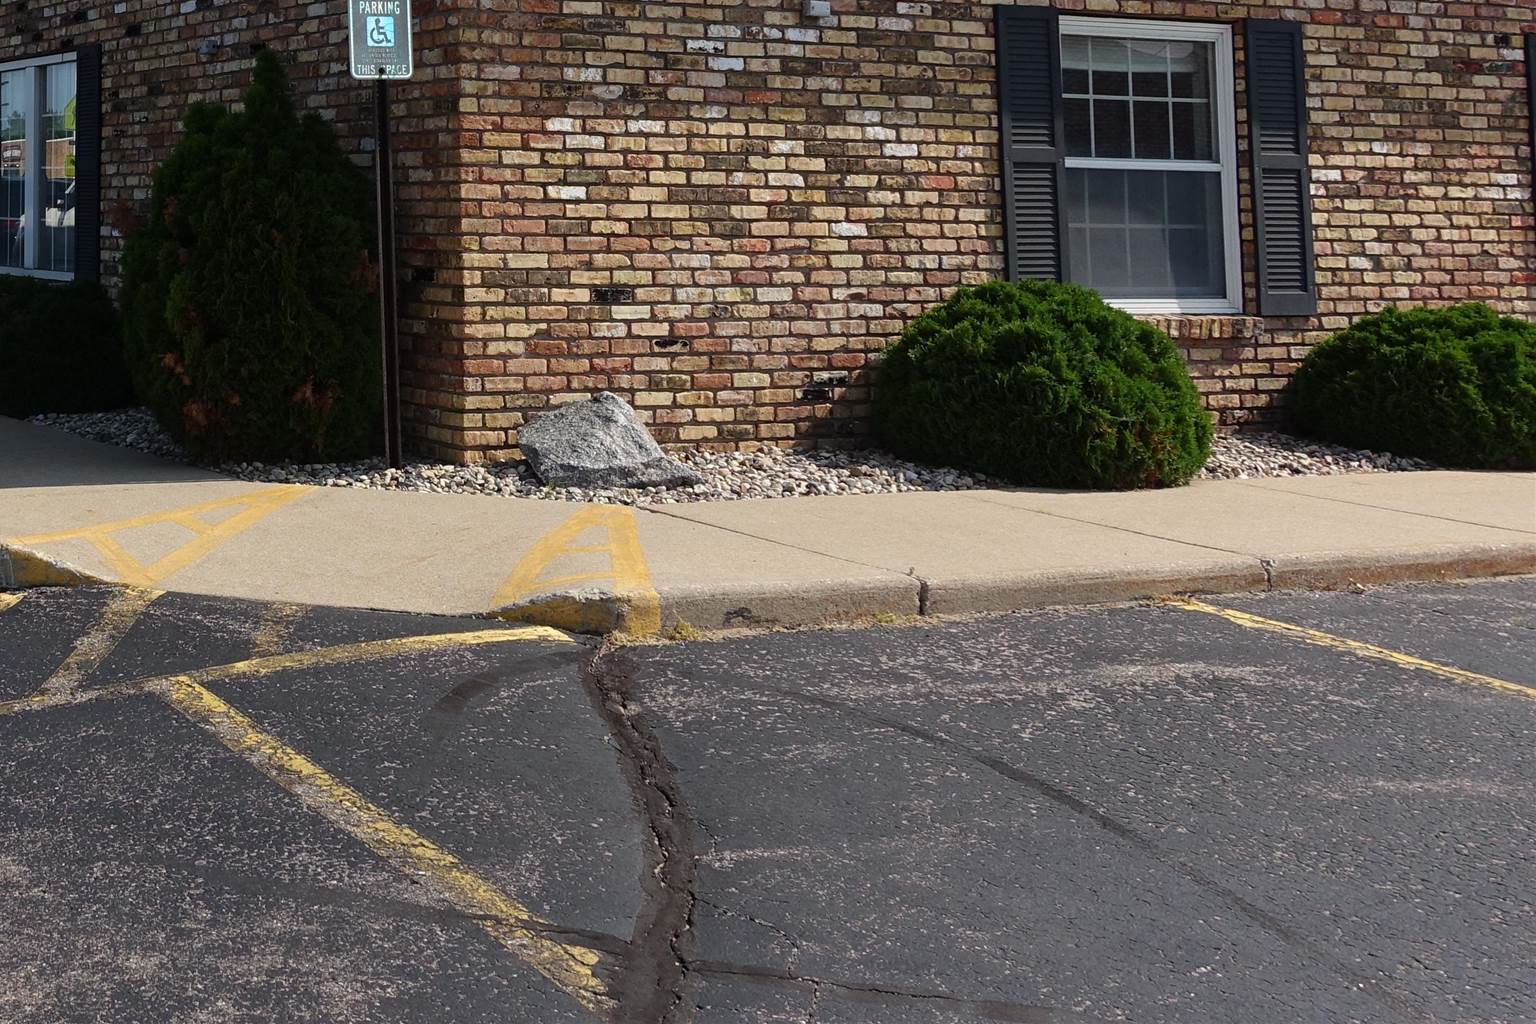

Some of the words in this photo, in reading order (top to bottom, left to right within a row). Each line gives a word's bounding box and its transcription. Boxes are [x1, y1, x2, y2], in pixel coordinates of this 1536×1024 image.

[359, 1, 400, 14] PARKING
[357, 64, 376, 75] THIS
[381, 64, 408, 75] PACE
